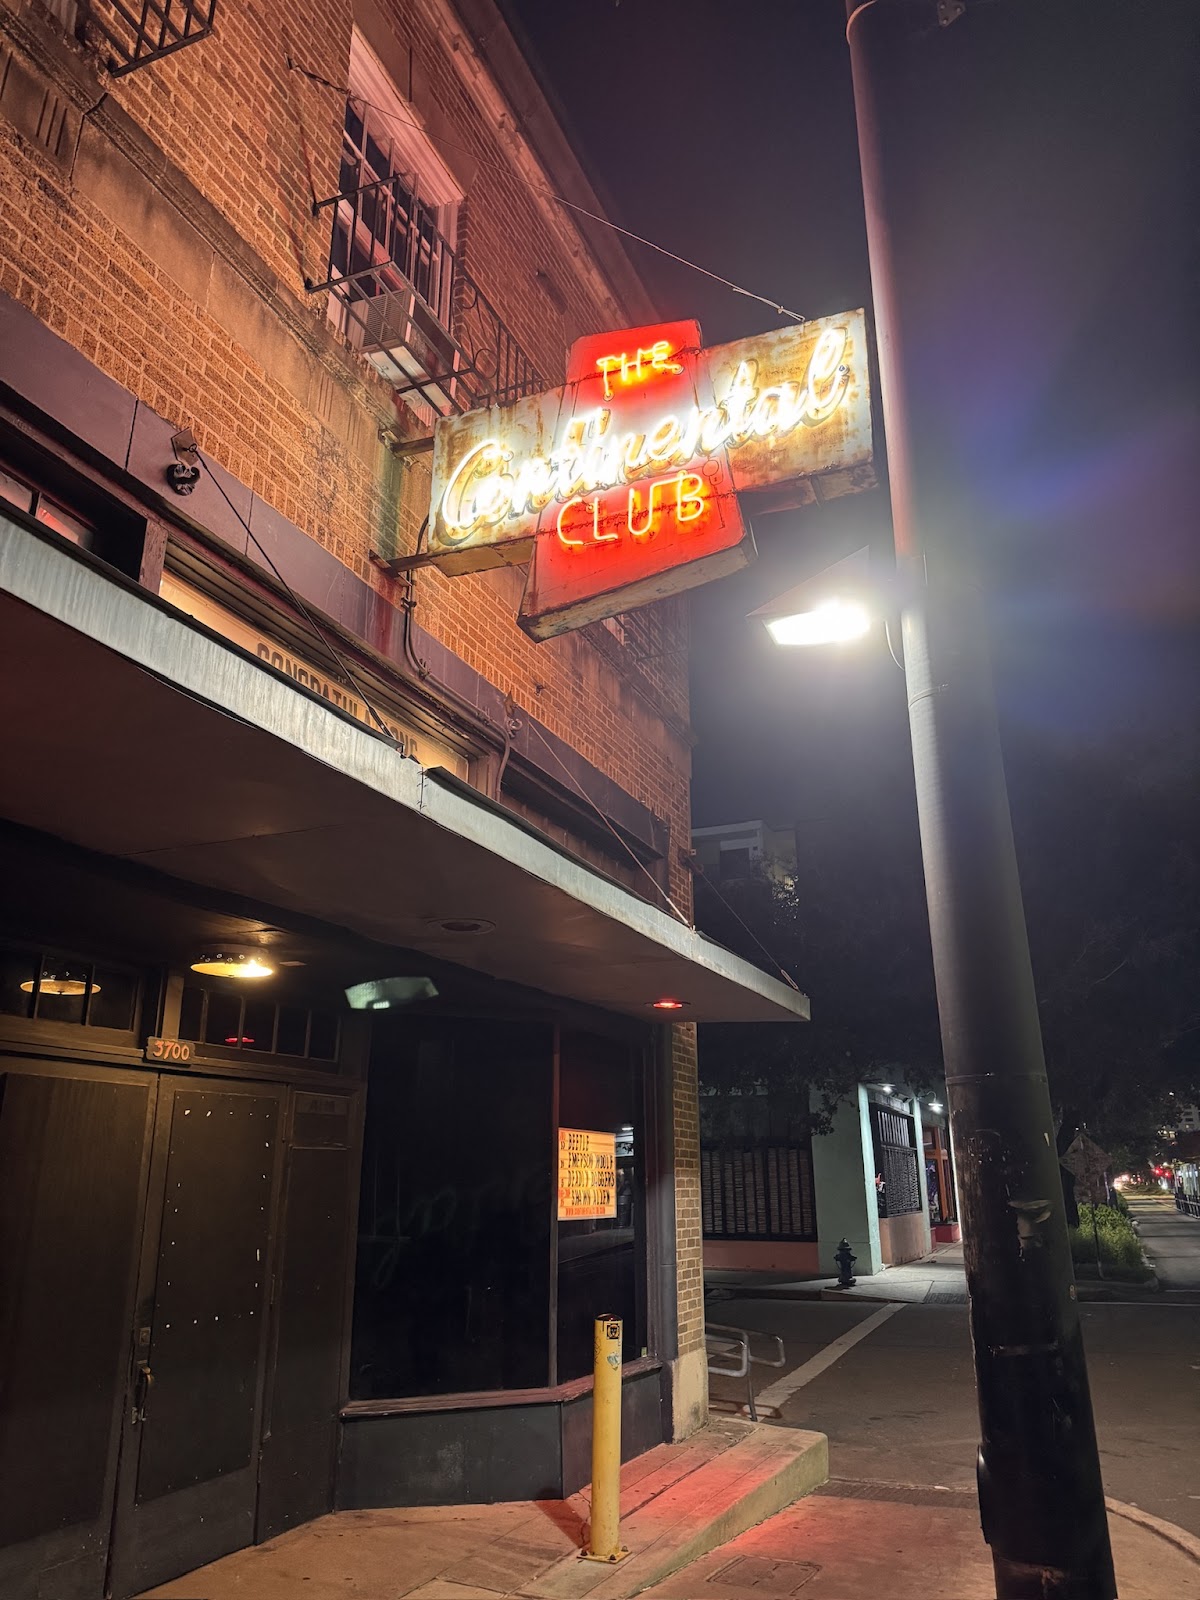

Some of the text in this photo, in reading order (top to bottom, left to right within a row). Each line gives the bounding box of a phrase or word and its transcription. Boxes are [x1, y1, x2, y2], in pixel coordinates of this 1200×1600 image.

[596, 340, 685, 400] THE
[439, 324, 849, 546] Continental
[557, 471, 706, 546] CLUB
[153, 1040, 190, 1061] 3700
